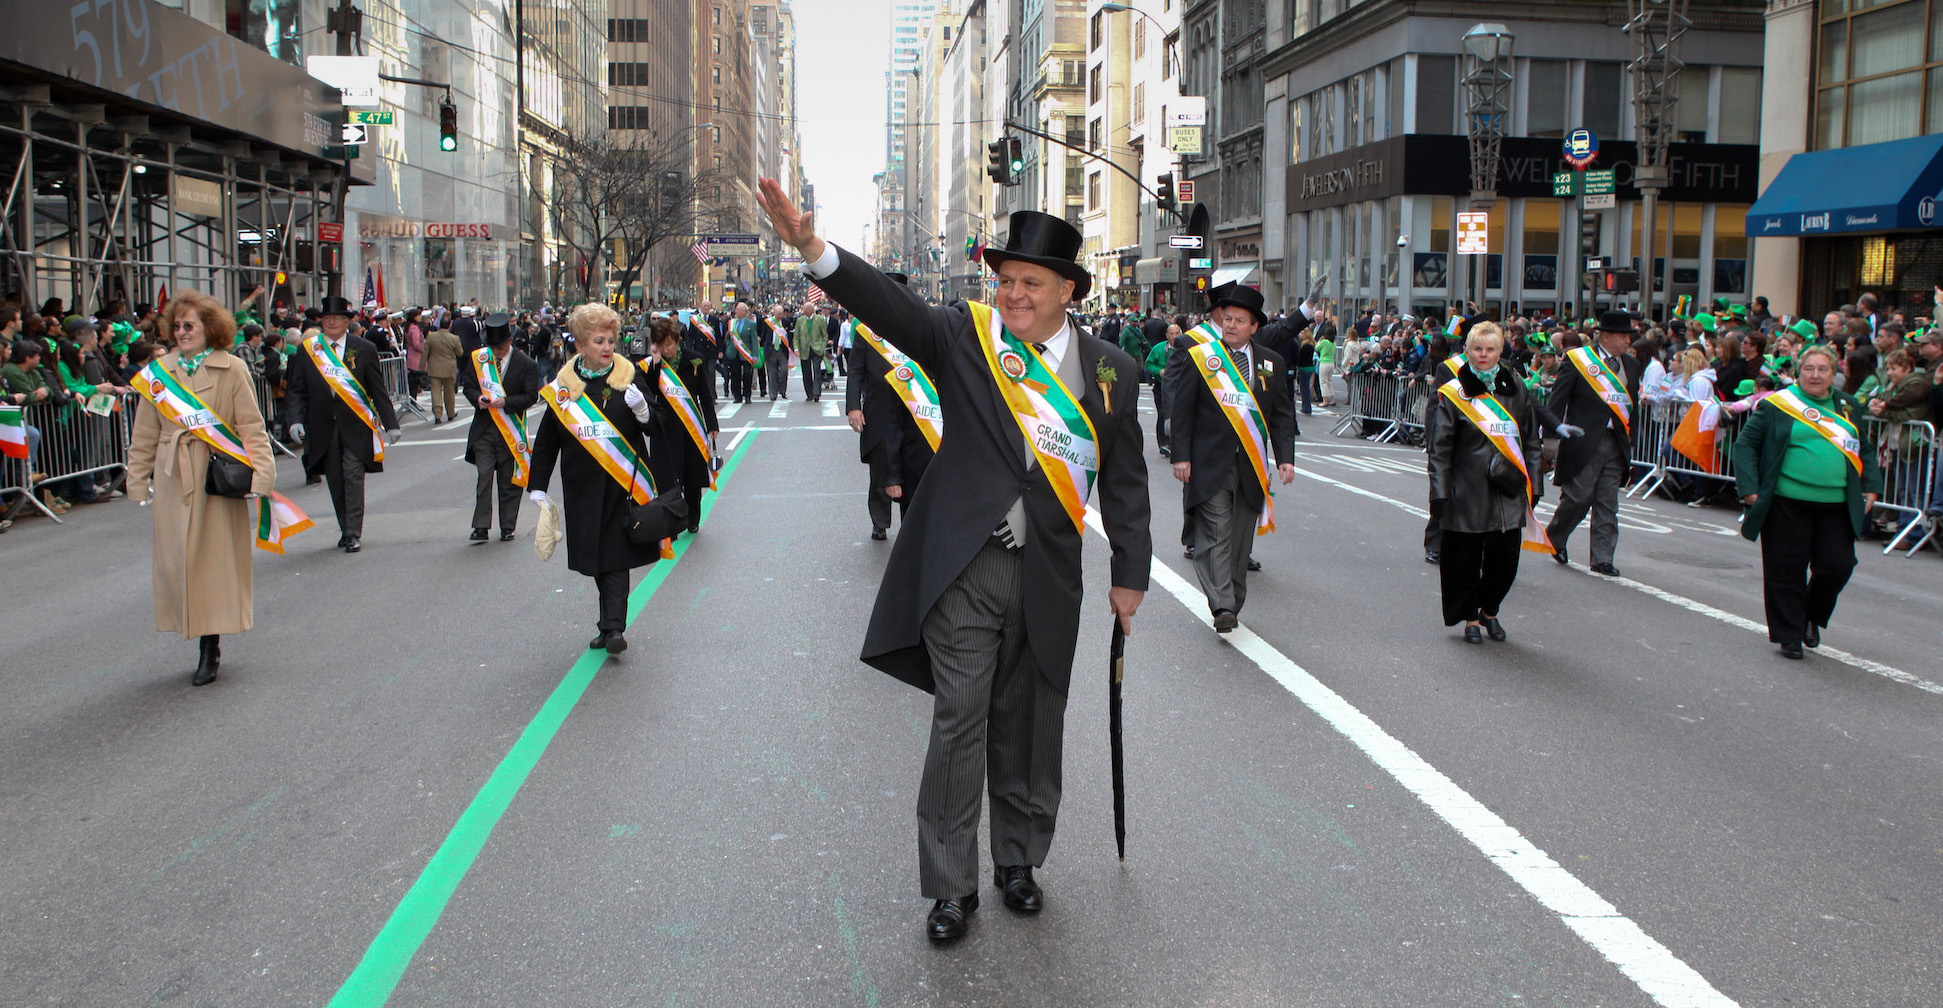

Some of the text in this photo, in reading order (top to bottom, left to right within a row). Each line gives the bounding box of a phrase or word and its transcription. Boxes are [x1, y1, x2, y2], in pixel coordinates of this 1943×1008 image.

[71, 0, 151, 87] 579
[125, 35, 246, 120] FTH
[355, 113, 362, 123] E
[366, 112, 382, 124] 47
[313, 115, 332, 137] FIFTH
[303, 128, 329, 150] AVENUE
[1301, 159, 1383, 199] JEWELERS ON FIFTH
[1555, 173, 1571, 183] x23
[1669, 156, 1739, 189] FIFTH
[1555, 185, 1571, 195] x24
[1846, 213, 1878, 226] Diamonds
[427, 223, 489, 238] GUESS
[325, 367, 341, 377] AIDE
[665, 387, 681, 396] AIDE
[1221, 392, 1245, 406] AIDE
[915, 404, 938, 419] AIDE
[577, 424, 600, 438] AIDE
[1037, 423, 1072, 447] GRAND
[1489, 423, 1509, 435] AIDE
[1036, 437, 1097, 469] MARSHAL 2012
